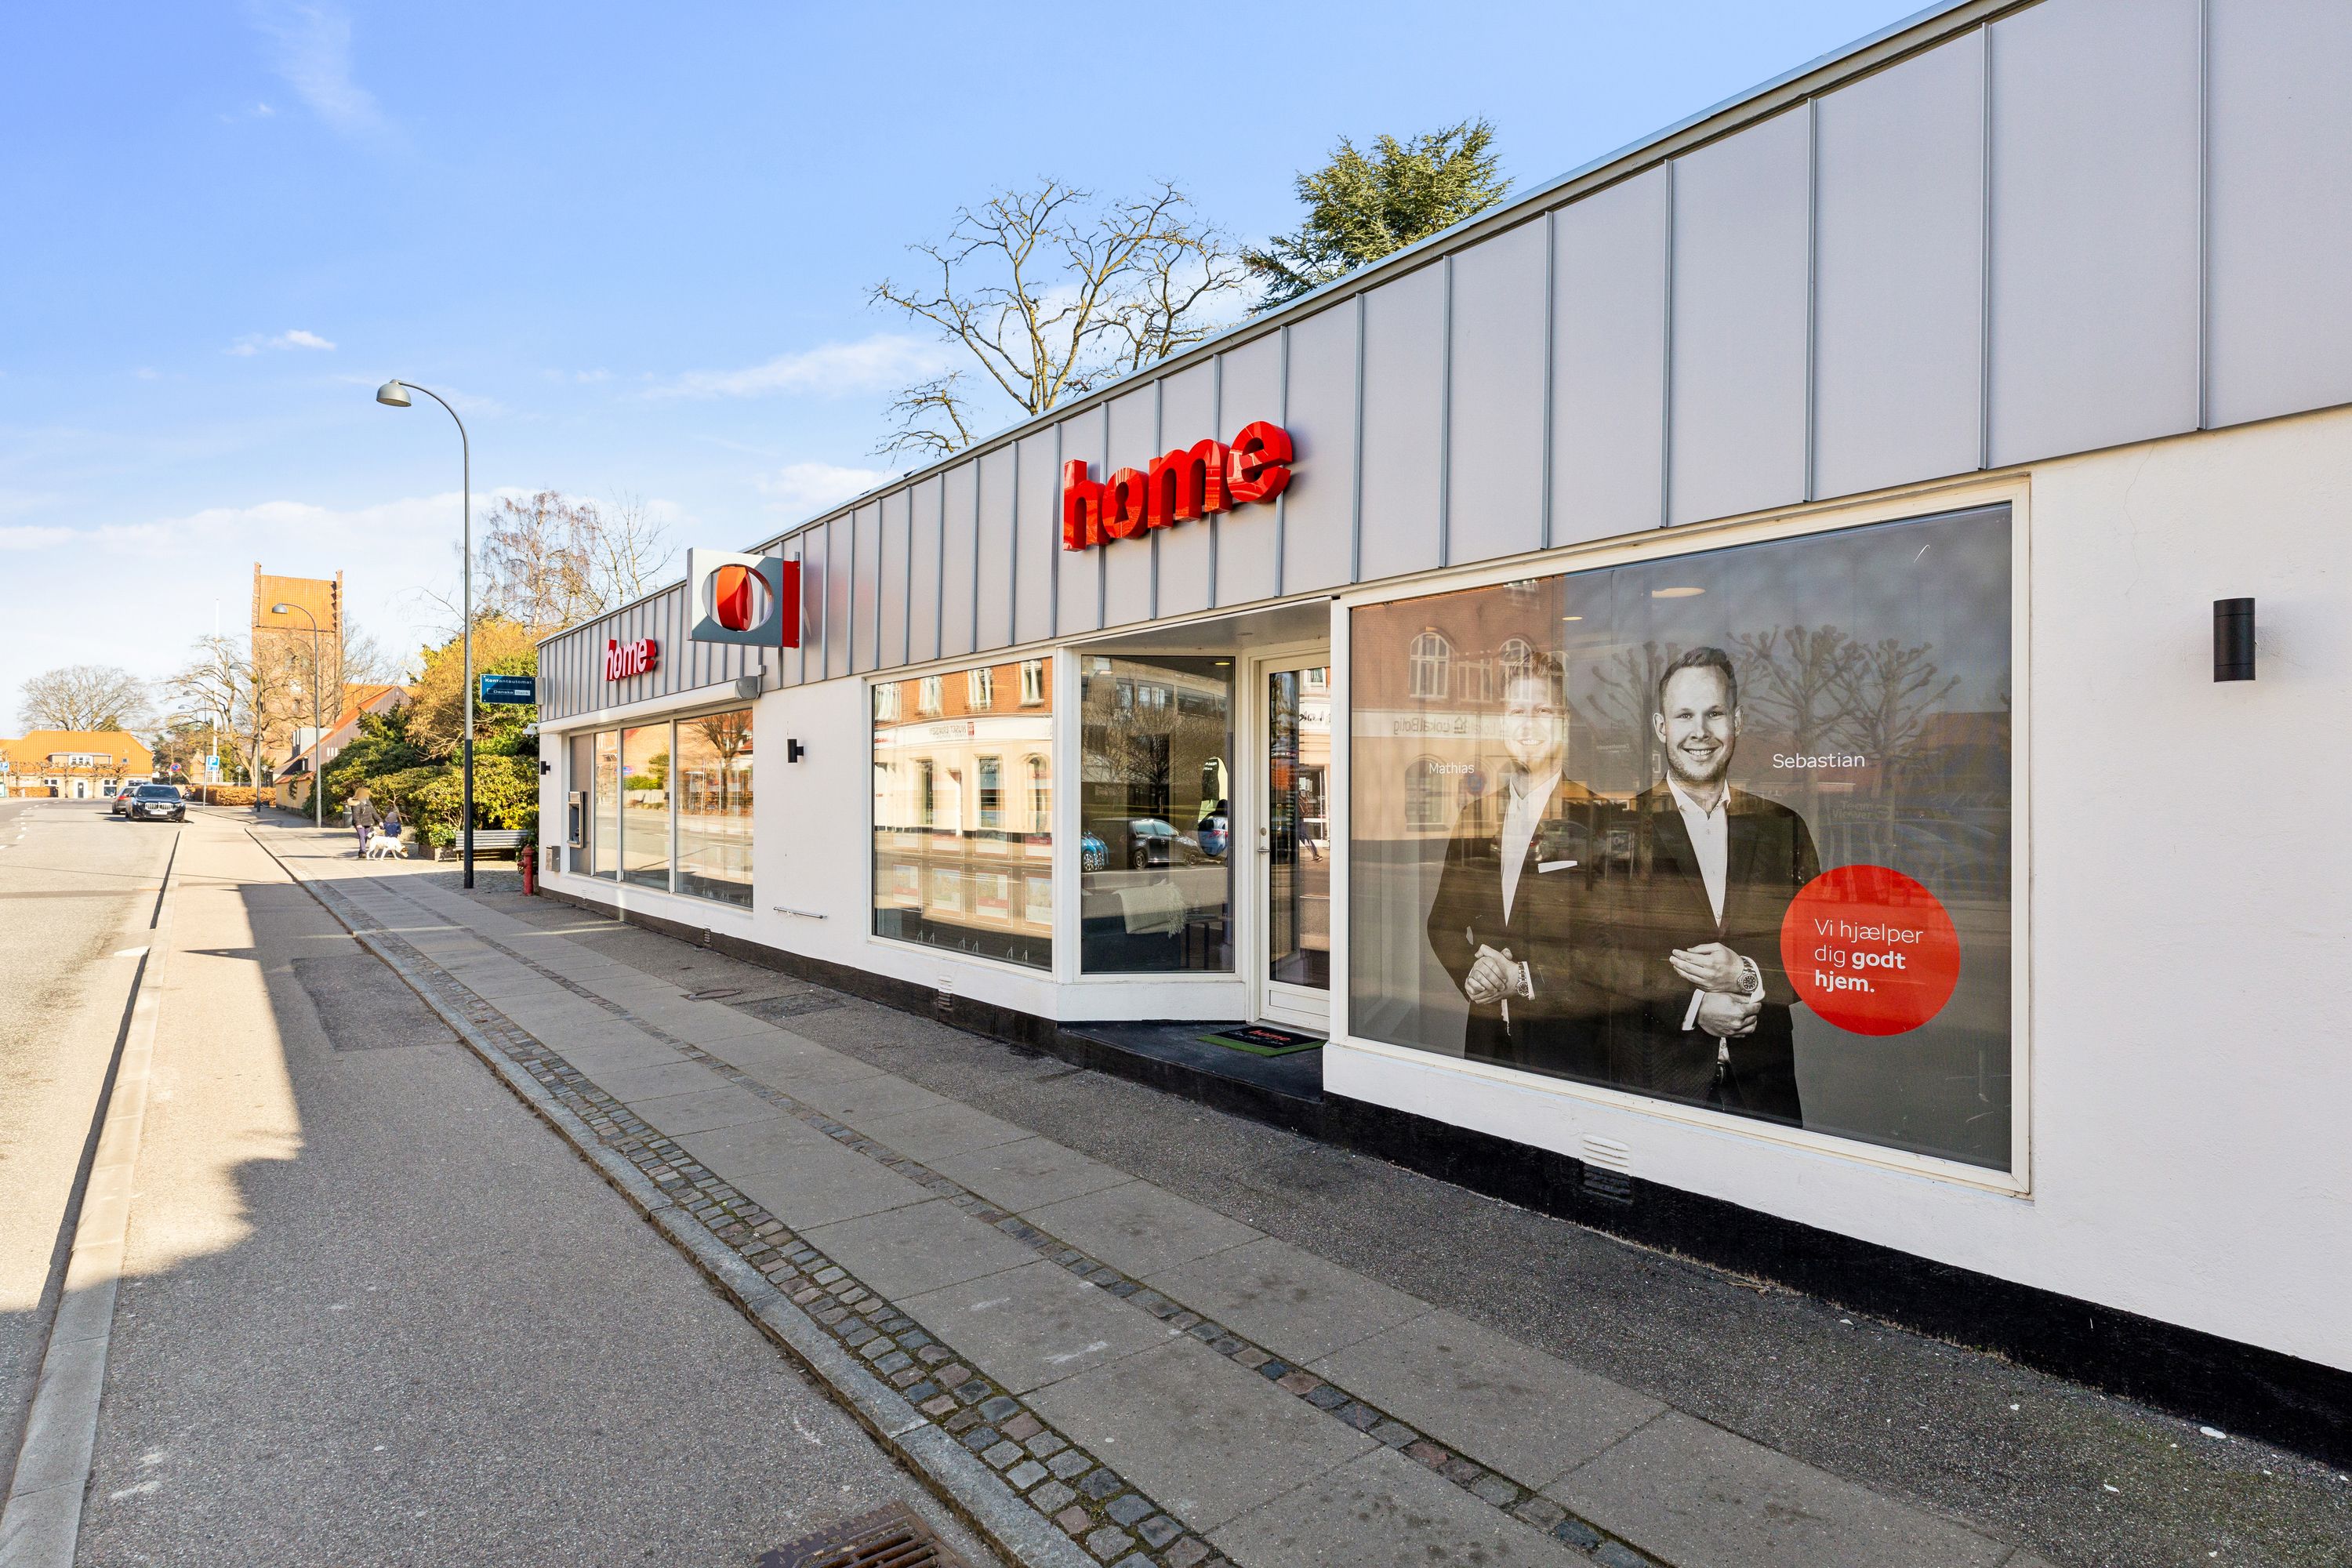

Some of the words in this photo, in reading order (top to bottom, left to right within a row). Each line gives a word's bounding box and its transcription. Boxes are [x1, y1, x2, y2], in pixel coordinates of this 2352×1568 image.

[1063, 420, 1293, 551] home
[605, 637, 657, 681] home
[1428, 762, 1475, 775] Mathias
[1773, 752, 1865, 768] Sebastian
[1814, 918, 1833, 937] Vi
[1840, 920, 1924, 946] hjælper
[1814, 944, 1846, 967] dig
[1852, 950, 1906, 970] godt
[1815, 969, 1875, 993] hjem.
